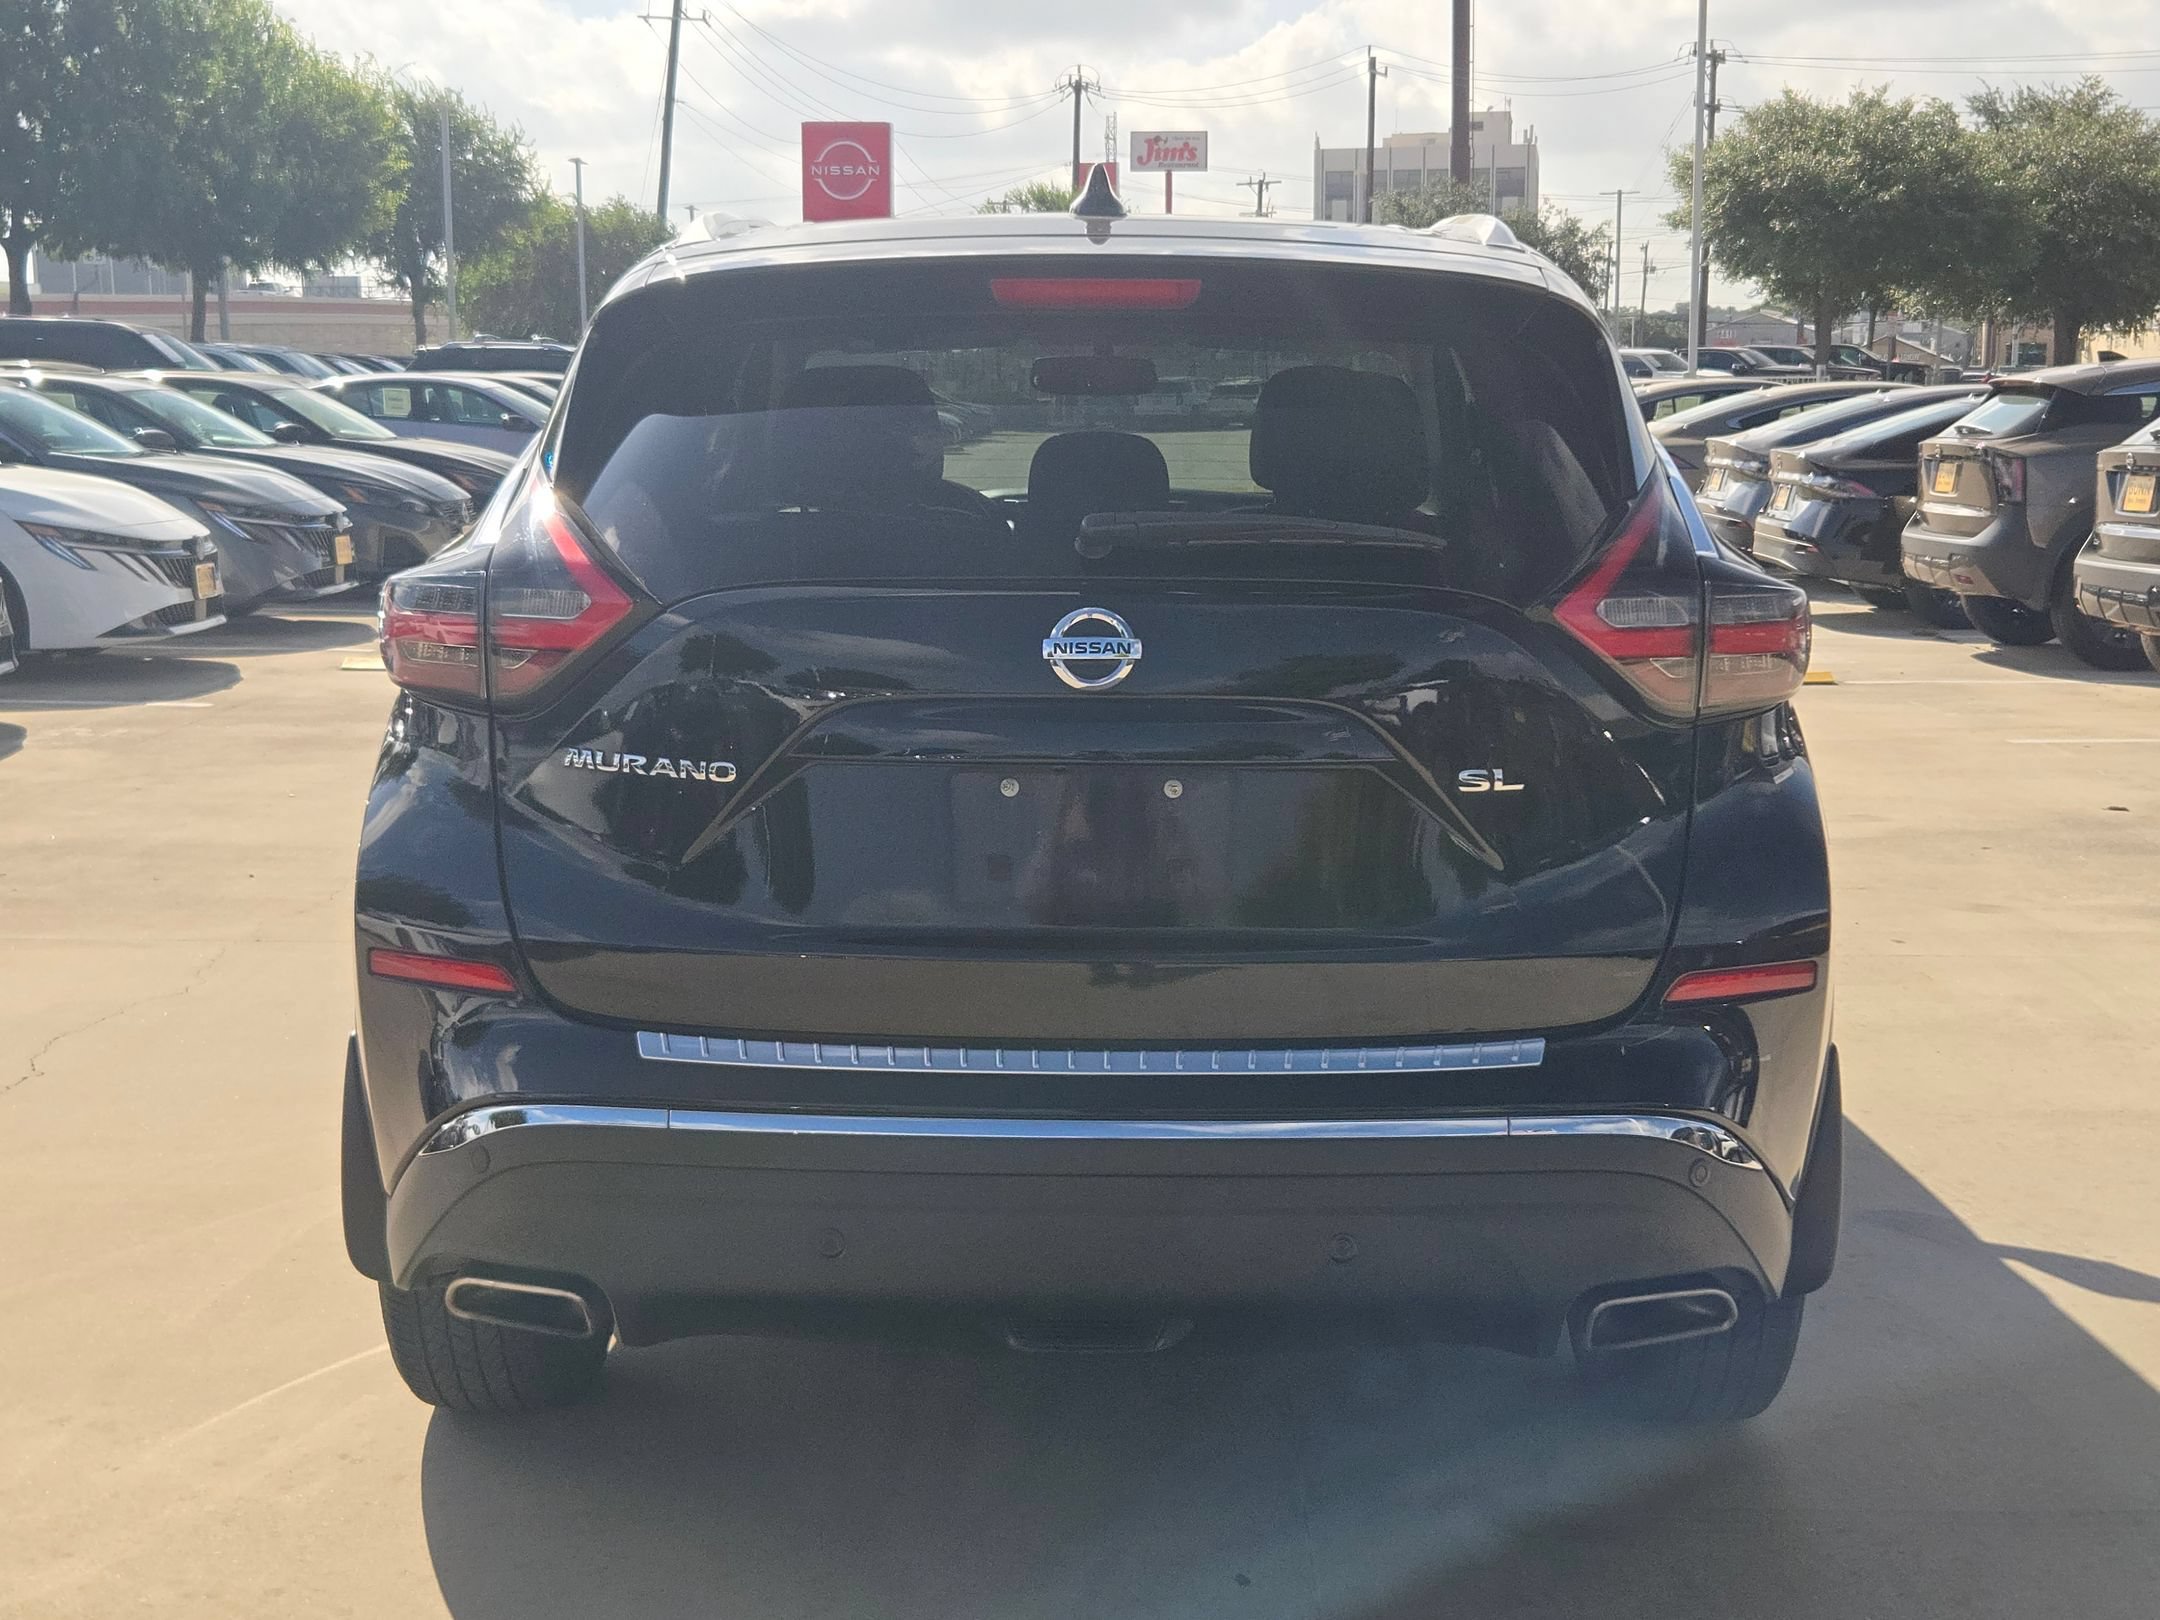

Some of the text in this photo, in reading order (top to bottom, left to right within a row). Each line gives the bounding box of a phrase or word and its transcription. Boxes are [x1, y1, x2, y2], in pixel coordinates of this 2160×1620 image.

[1136, 138, 1198, 166] Jim's
[811, 165, 880, 176] NISSAN
[1053, 642, 1131, 655] NISSAN
[563, 748, 737, 783] MURANO
[1458, 768, 1525, 792] SL
